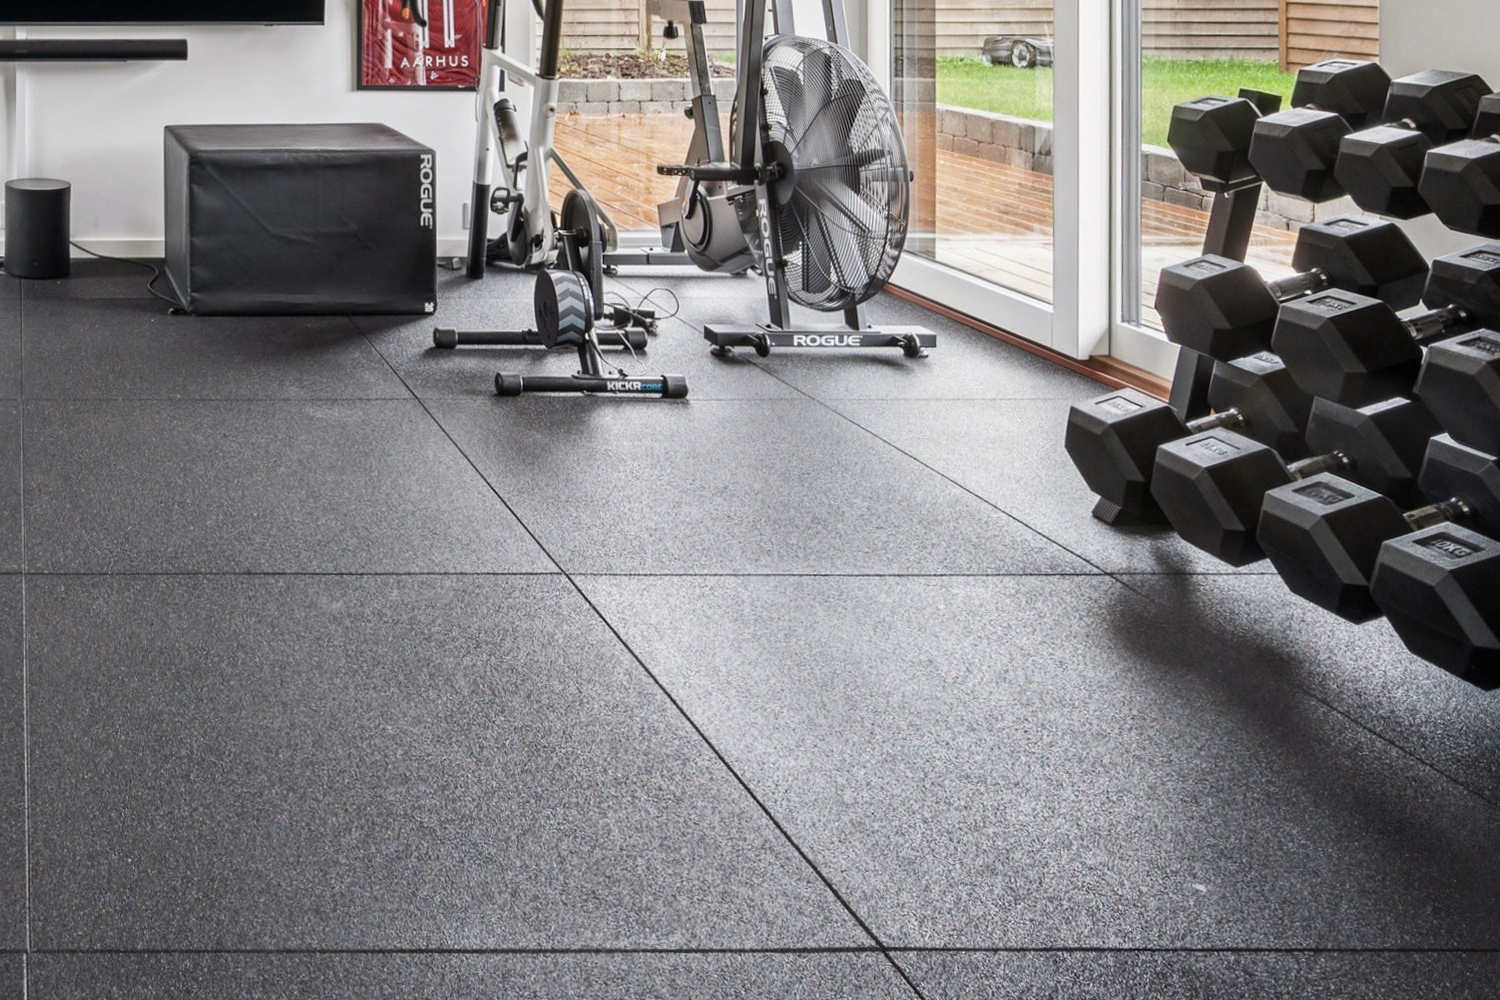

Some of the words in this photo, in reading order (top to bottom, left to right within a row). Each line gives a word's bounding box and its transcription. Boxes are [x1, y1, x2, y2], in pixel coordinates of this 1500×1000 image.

[400, 55, 469, 69] AARHUS
[419, 153, 433, 227] ROGUE
[759, 198, 777, 295] ROGUE
[793, 334, 861, 346] ROGUE
[606, 381, 641, 391] KICKR
